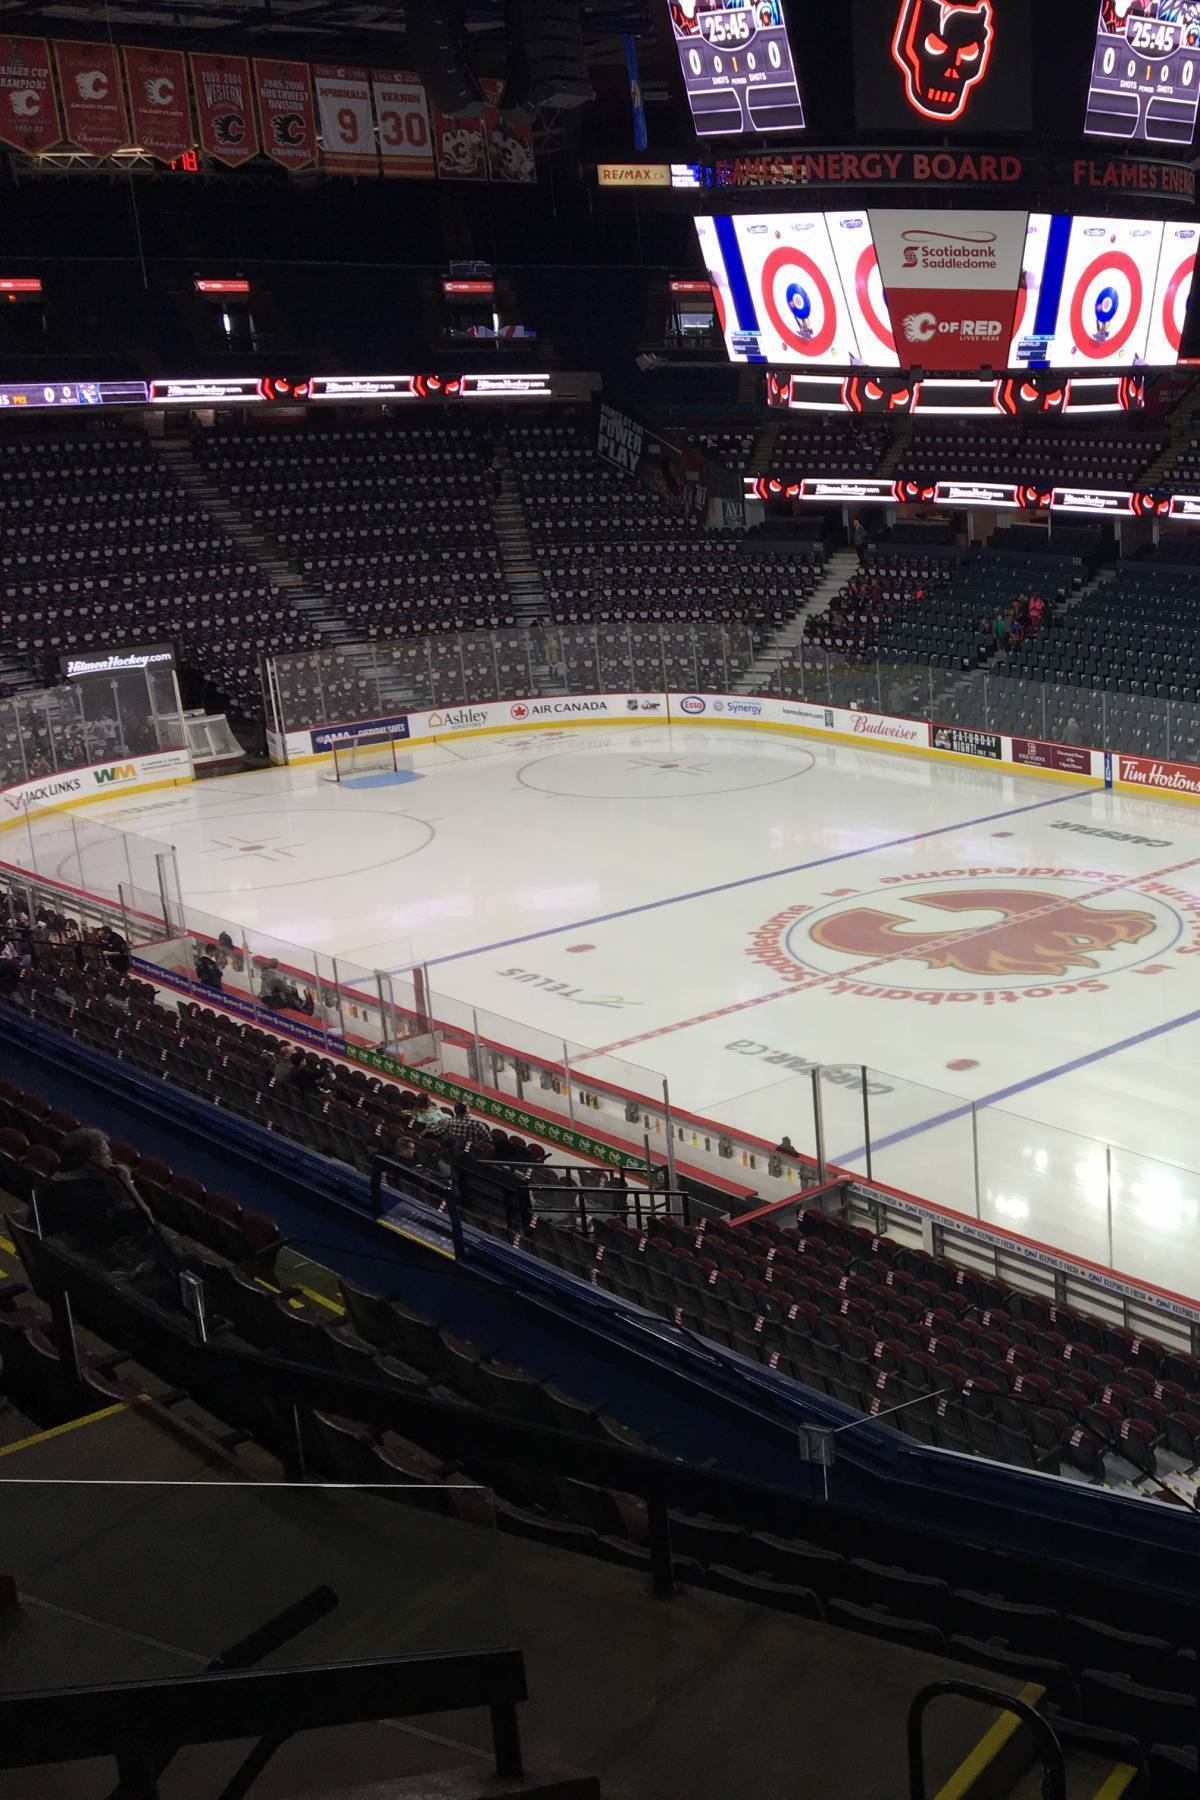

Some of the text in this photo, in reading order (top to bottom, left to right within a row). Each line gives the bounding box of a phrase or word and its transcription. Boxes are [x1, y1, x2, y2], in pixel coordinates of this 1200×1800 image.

[705, 13, 750, 42] 25:45
[1131, 22, 1175, 52] 25:45
[689, 41, 781, 75] 0 0 1 0 0
[1103, 47, 1194, 86] 0 0 1 0 0
[749, 72, 767, 81] SHOTS
[1120, 80, 1138, 89] SHOTS
[1157, 85, 1174, 95] SHOTS
[204, 83, 245, 111] WESTERN
[260, 88, 309, 102] NORTHWEST
[268, 100, 304, 112] DIVISION
[337, 108, 358, 144] 9
[381, 111, 427, 147] 30
[791, 153, 903, 181] ENERGY
[911, 153, 1023, 182] BOARD
[1073, 159, 1158, 190] FLAMES
[921, 246, 997, 258] Scotiabank
[921, 258, 997, 269] Saddledome
[938, 319, 1002, 336] OF RED
[44, 387, 55, 403] 0
[63, 386, 71, 397] 0
[597, 432, 640, 473] PLAY
[67, 652, 173, 677] HitmenHockey.com
[443, 709, 488, 727] Ashley
[531, 701, 608, 714] AIR CANADA
[727, 702, 762, 716] Synergy
[324, 731, 350, 745] AMA
[850, 714, 918, 741] Budweiser
[93, 763, 138, 784] WM
[1121, 759, 1149, 781] Tim
[25, 786, 49, 804] JACK
[879, 866, 1128, 885] Saddledome
[744, 903, 820, 984] Saddledome
[497, 967, 583, 997] TELUS
[824, 979, 1110, 1005] Scotiabank
